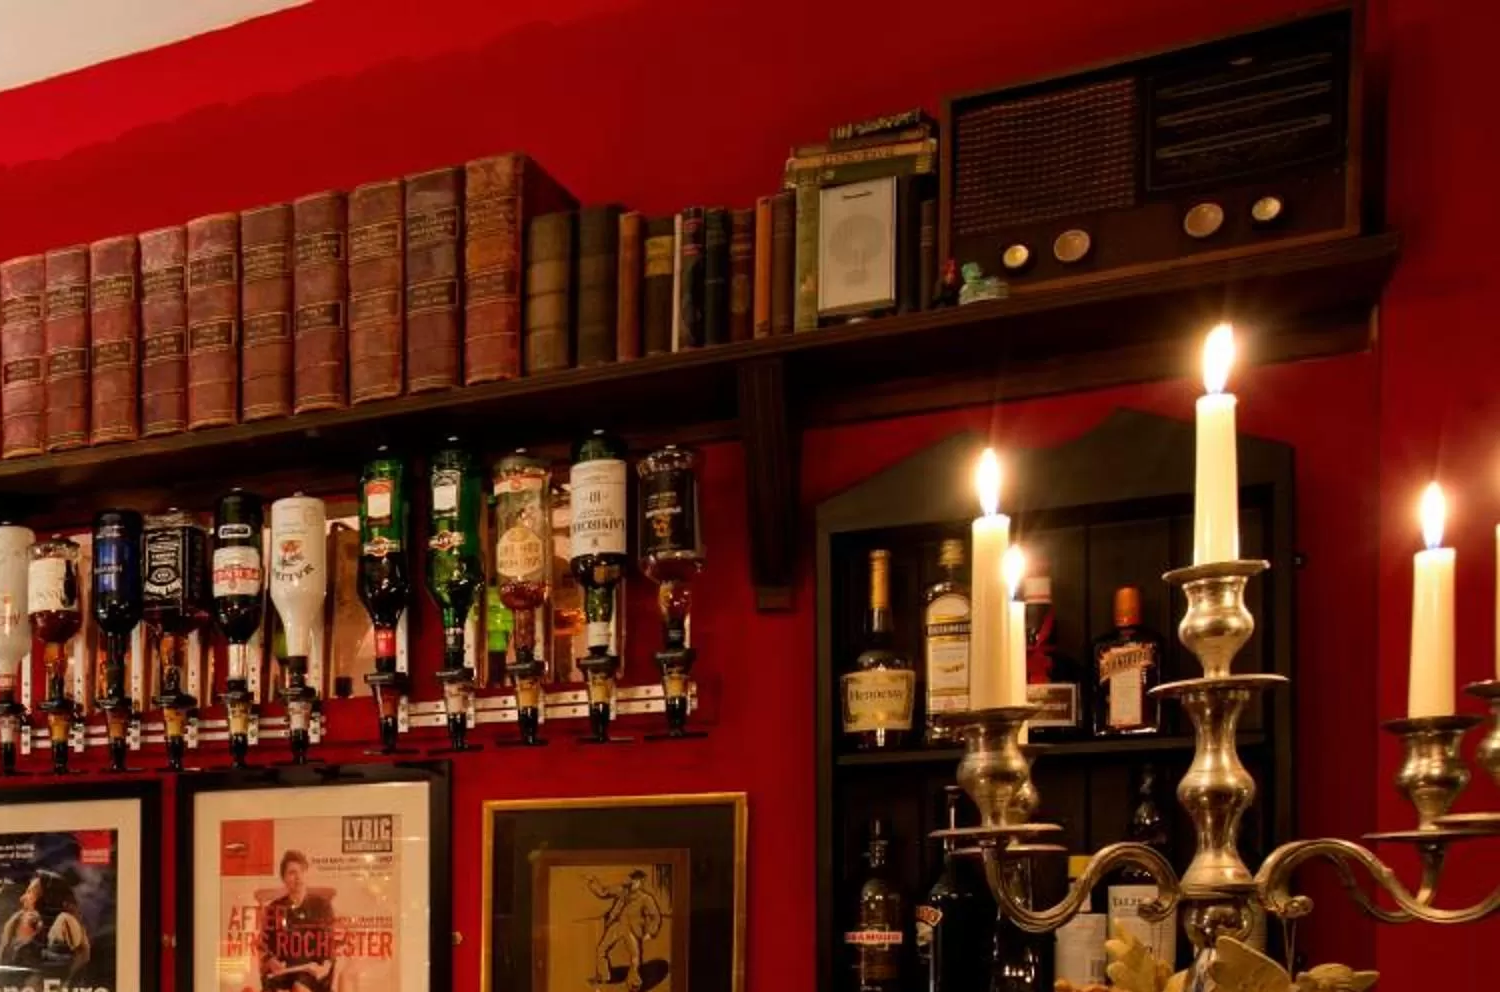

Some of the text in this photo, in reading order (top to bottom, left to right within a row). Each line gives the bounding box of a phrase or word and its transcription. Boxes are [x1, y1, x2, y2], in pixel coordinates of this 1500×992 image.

[345, 818, 391, 841] LYRIC
[228, 904, 287, 932] AFTER
[276, 930, 394, 961] ROCHESTER
